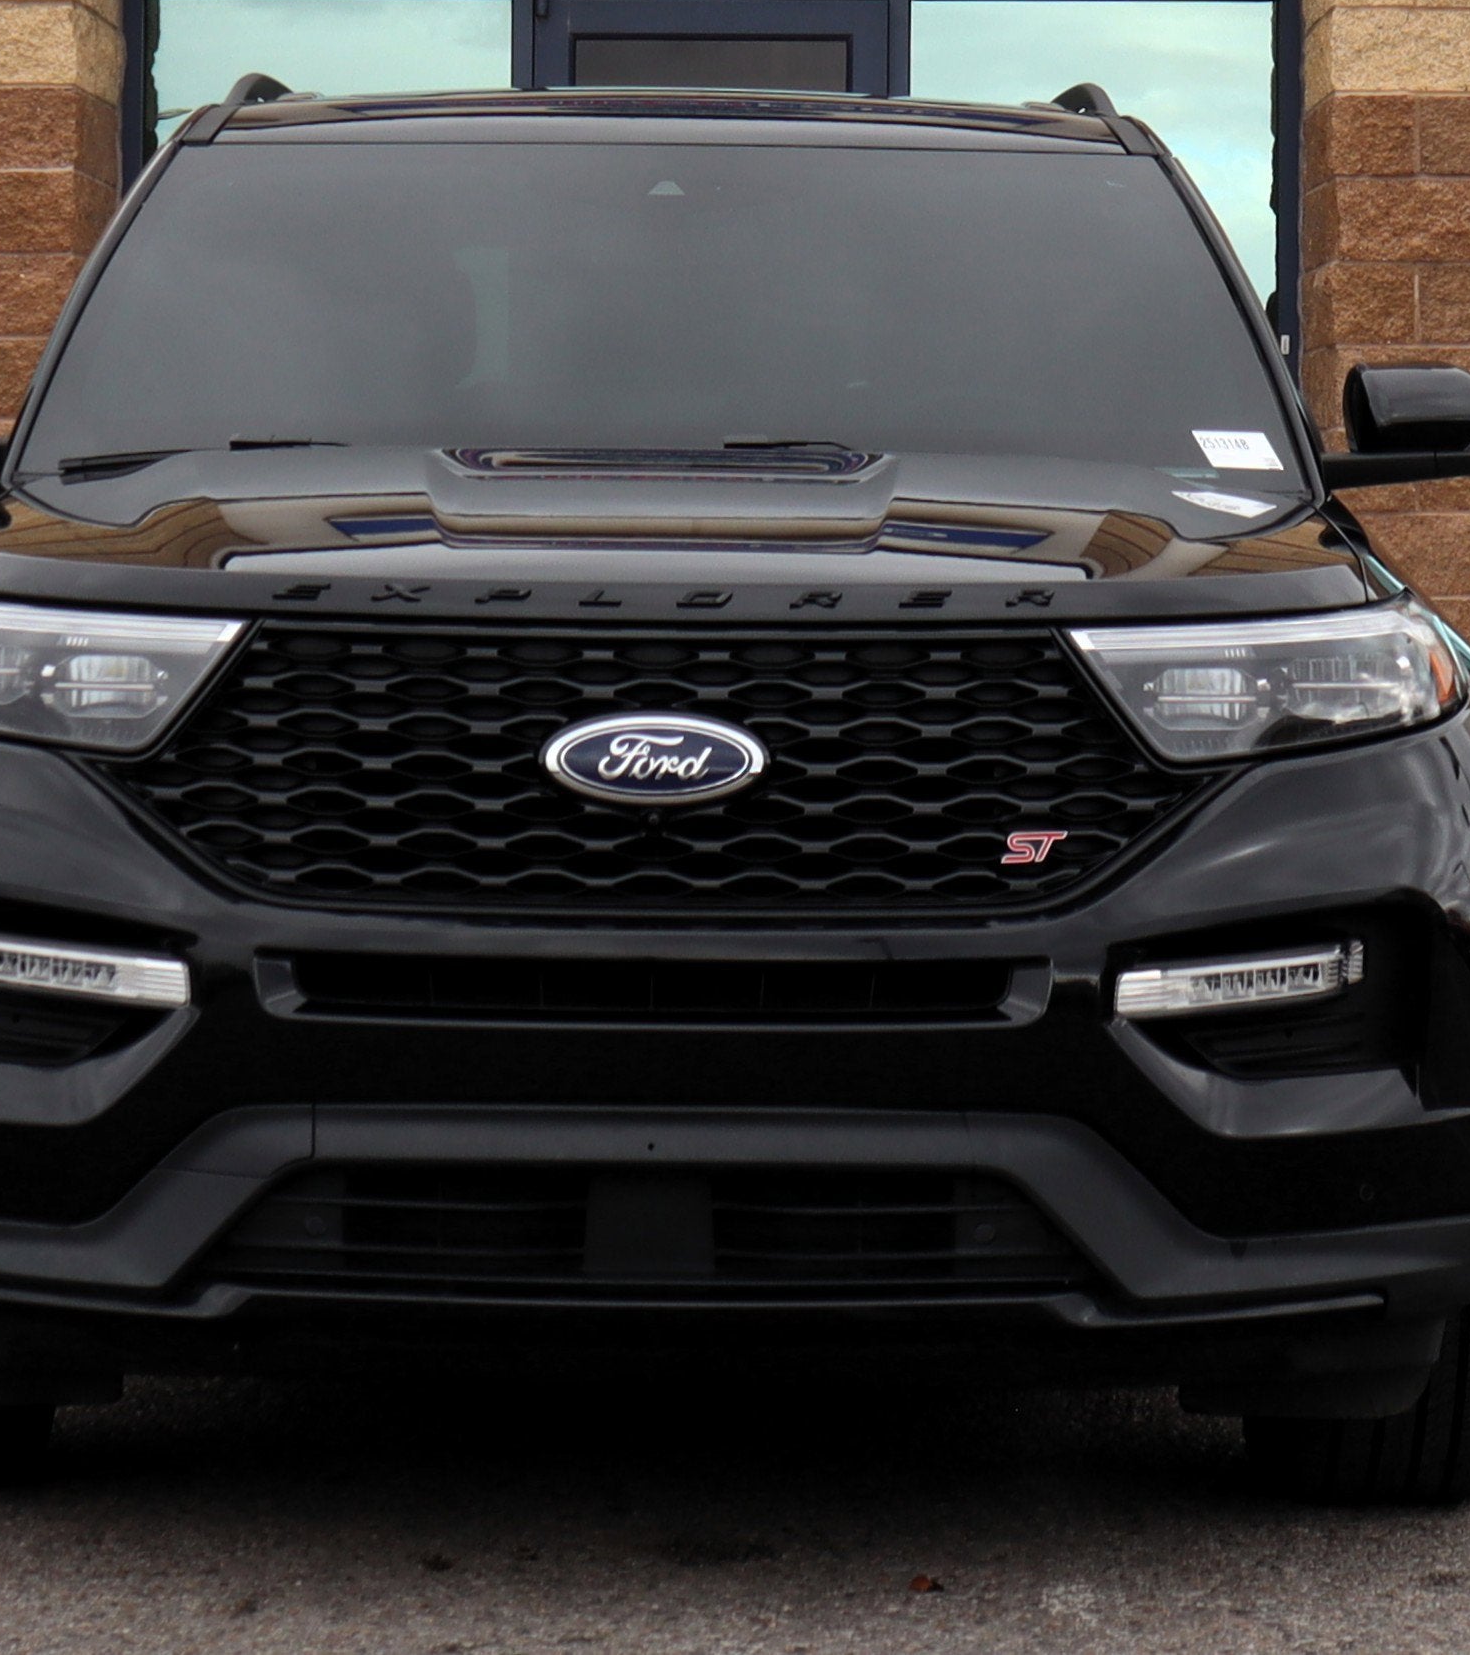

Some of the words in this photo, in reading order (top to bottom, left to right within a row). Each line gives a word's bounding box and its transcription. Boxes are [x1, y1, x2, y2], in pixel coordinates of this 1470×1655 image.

[273, 582, 1055, 609] EXPLORER
[598, 733, 712, 780] Ford
[1001, 831, 1068, 864] ST
